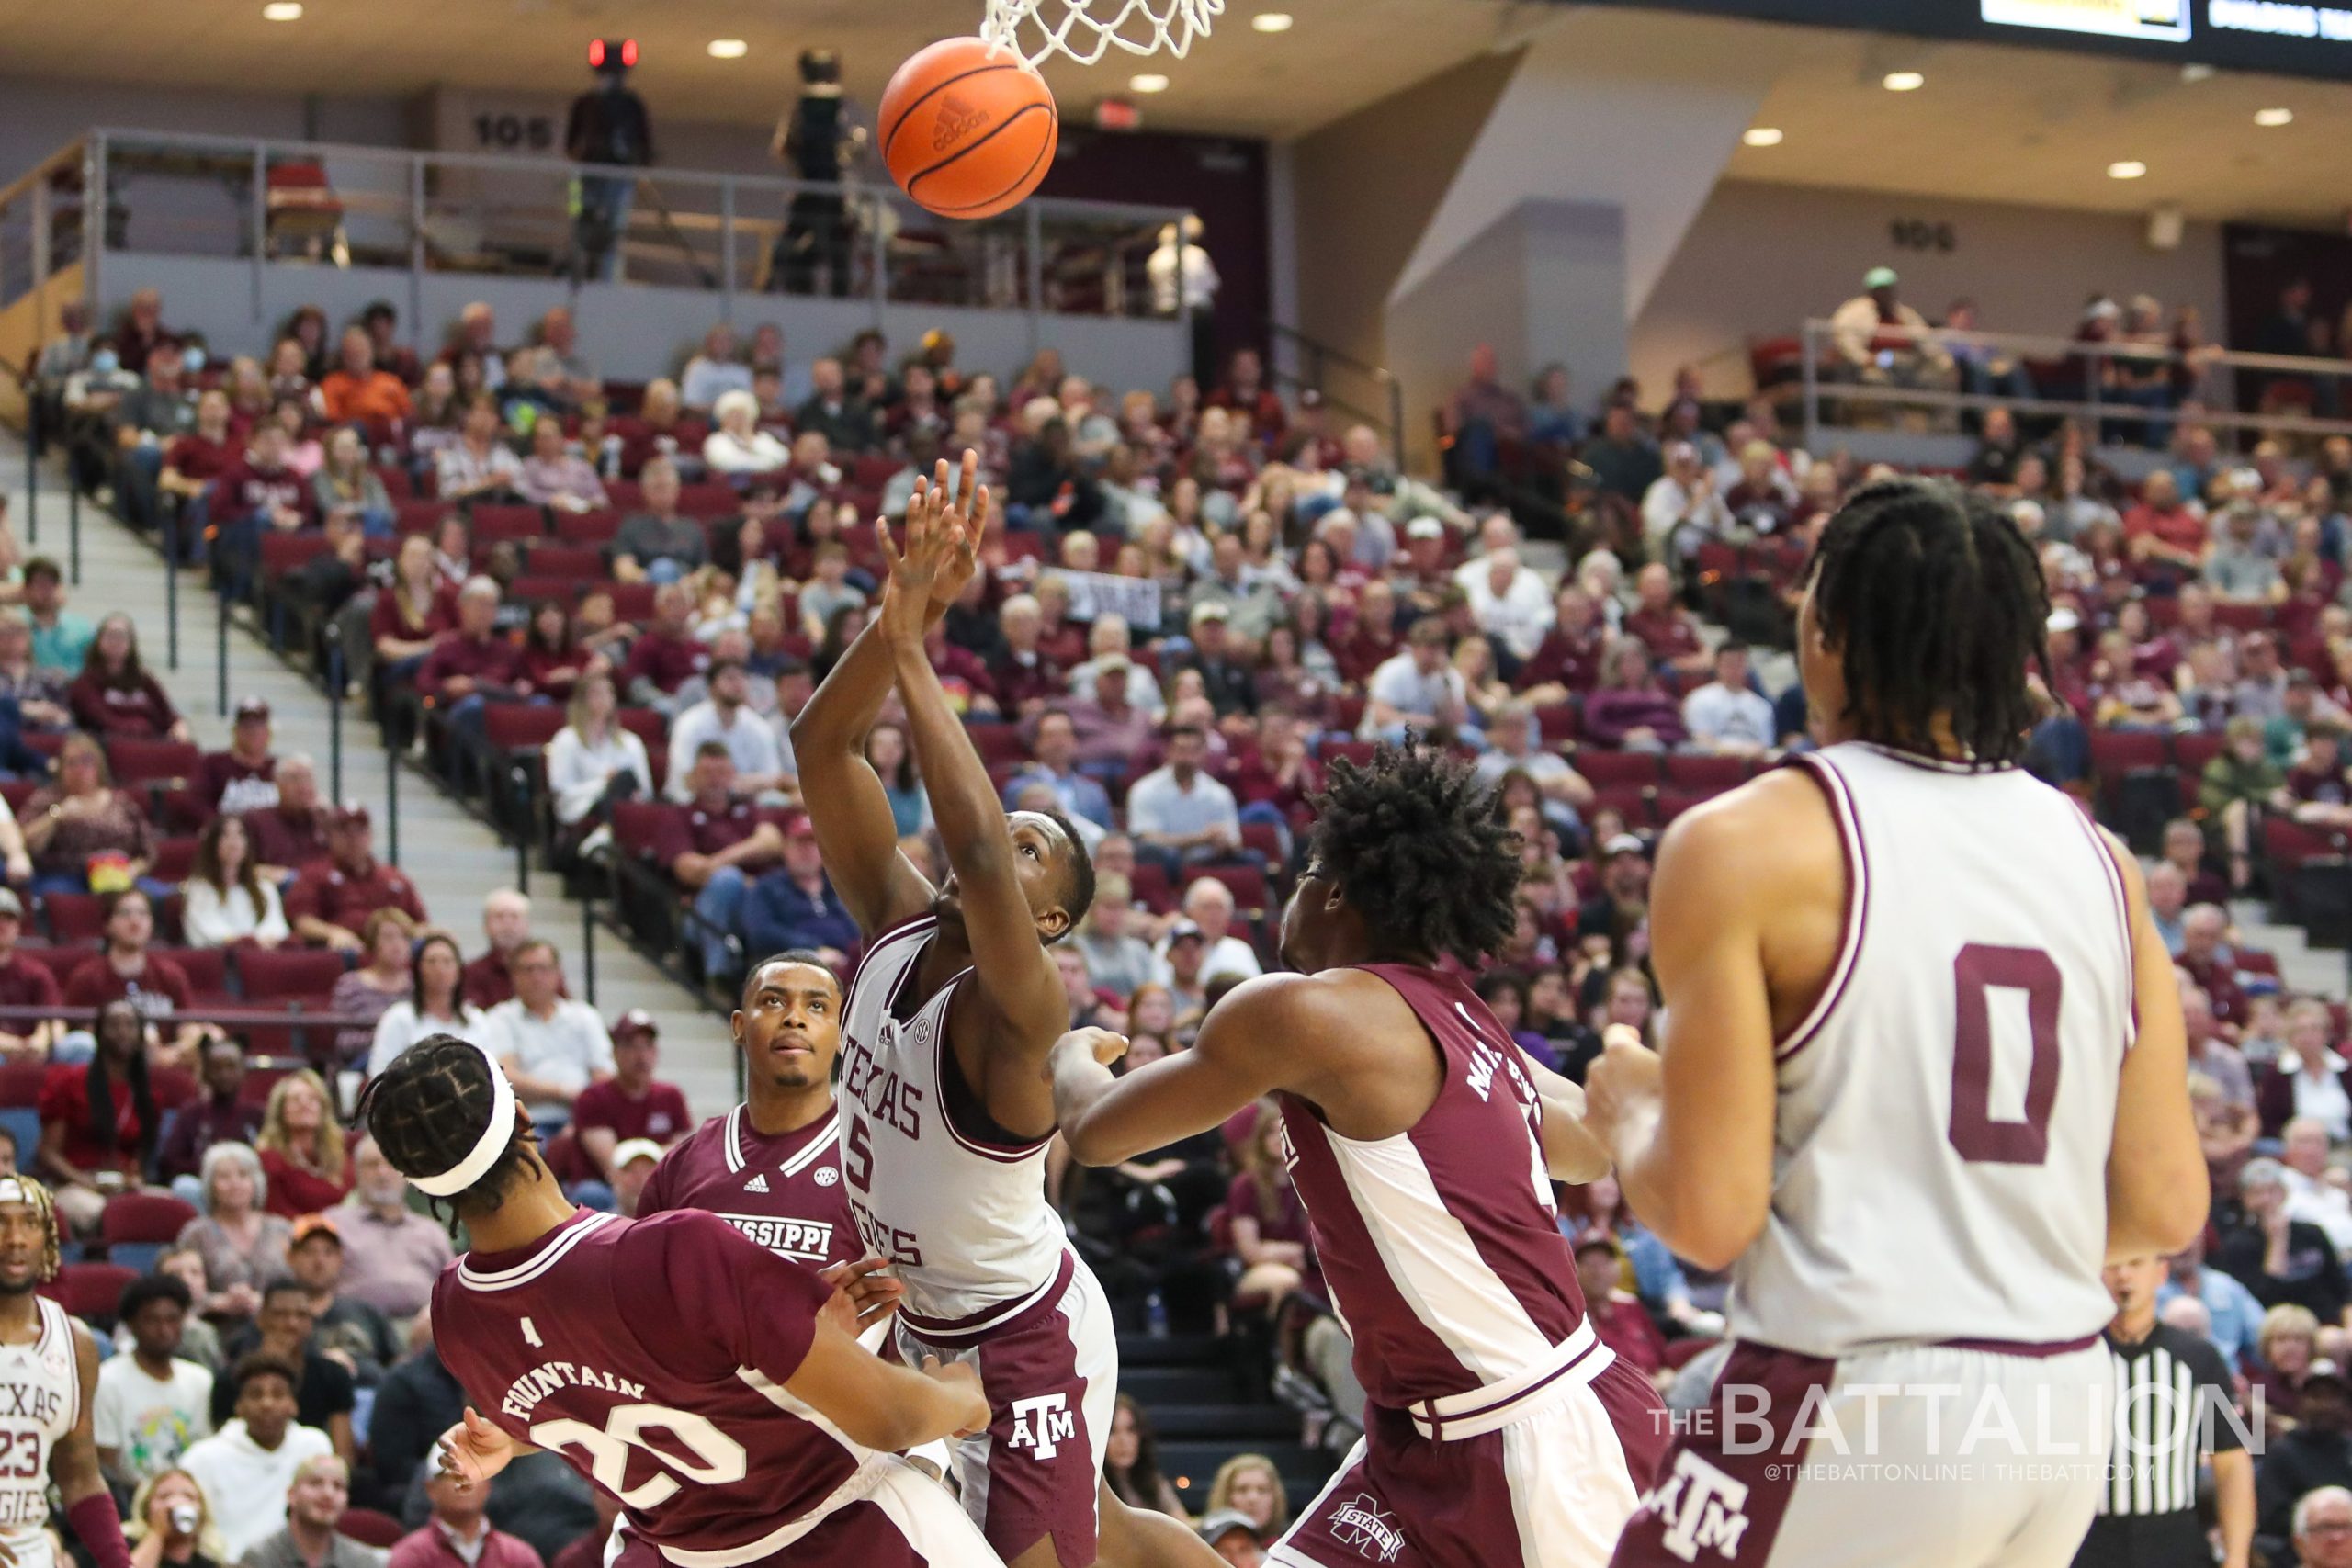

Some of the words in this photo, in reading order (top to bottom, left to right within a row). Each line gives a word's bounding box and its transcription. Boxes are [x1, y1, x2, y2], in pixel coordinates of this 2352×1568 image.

[475, 114, 553, 148] 105
[933, 109, 990, 152] adidas
[1948, 942, 2063, 1165] 0
[845, 1112, 874, 1194] 5
[0, 1384, 61, 1427] XAS
[502, 1361, 645, 1421] FOUNTAIN
[529, 1404, 747, 1509] 20
[1346, 1511, 1391, 1546] STATE
